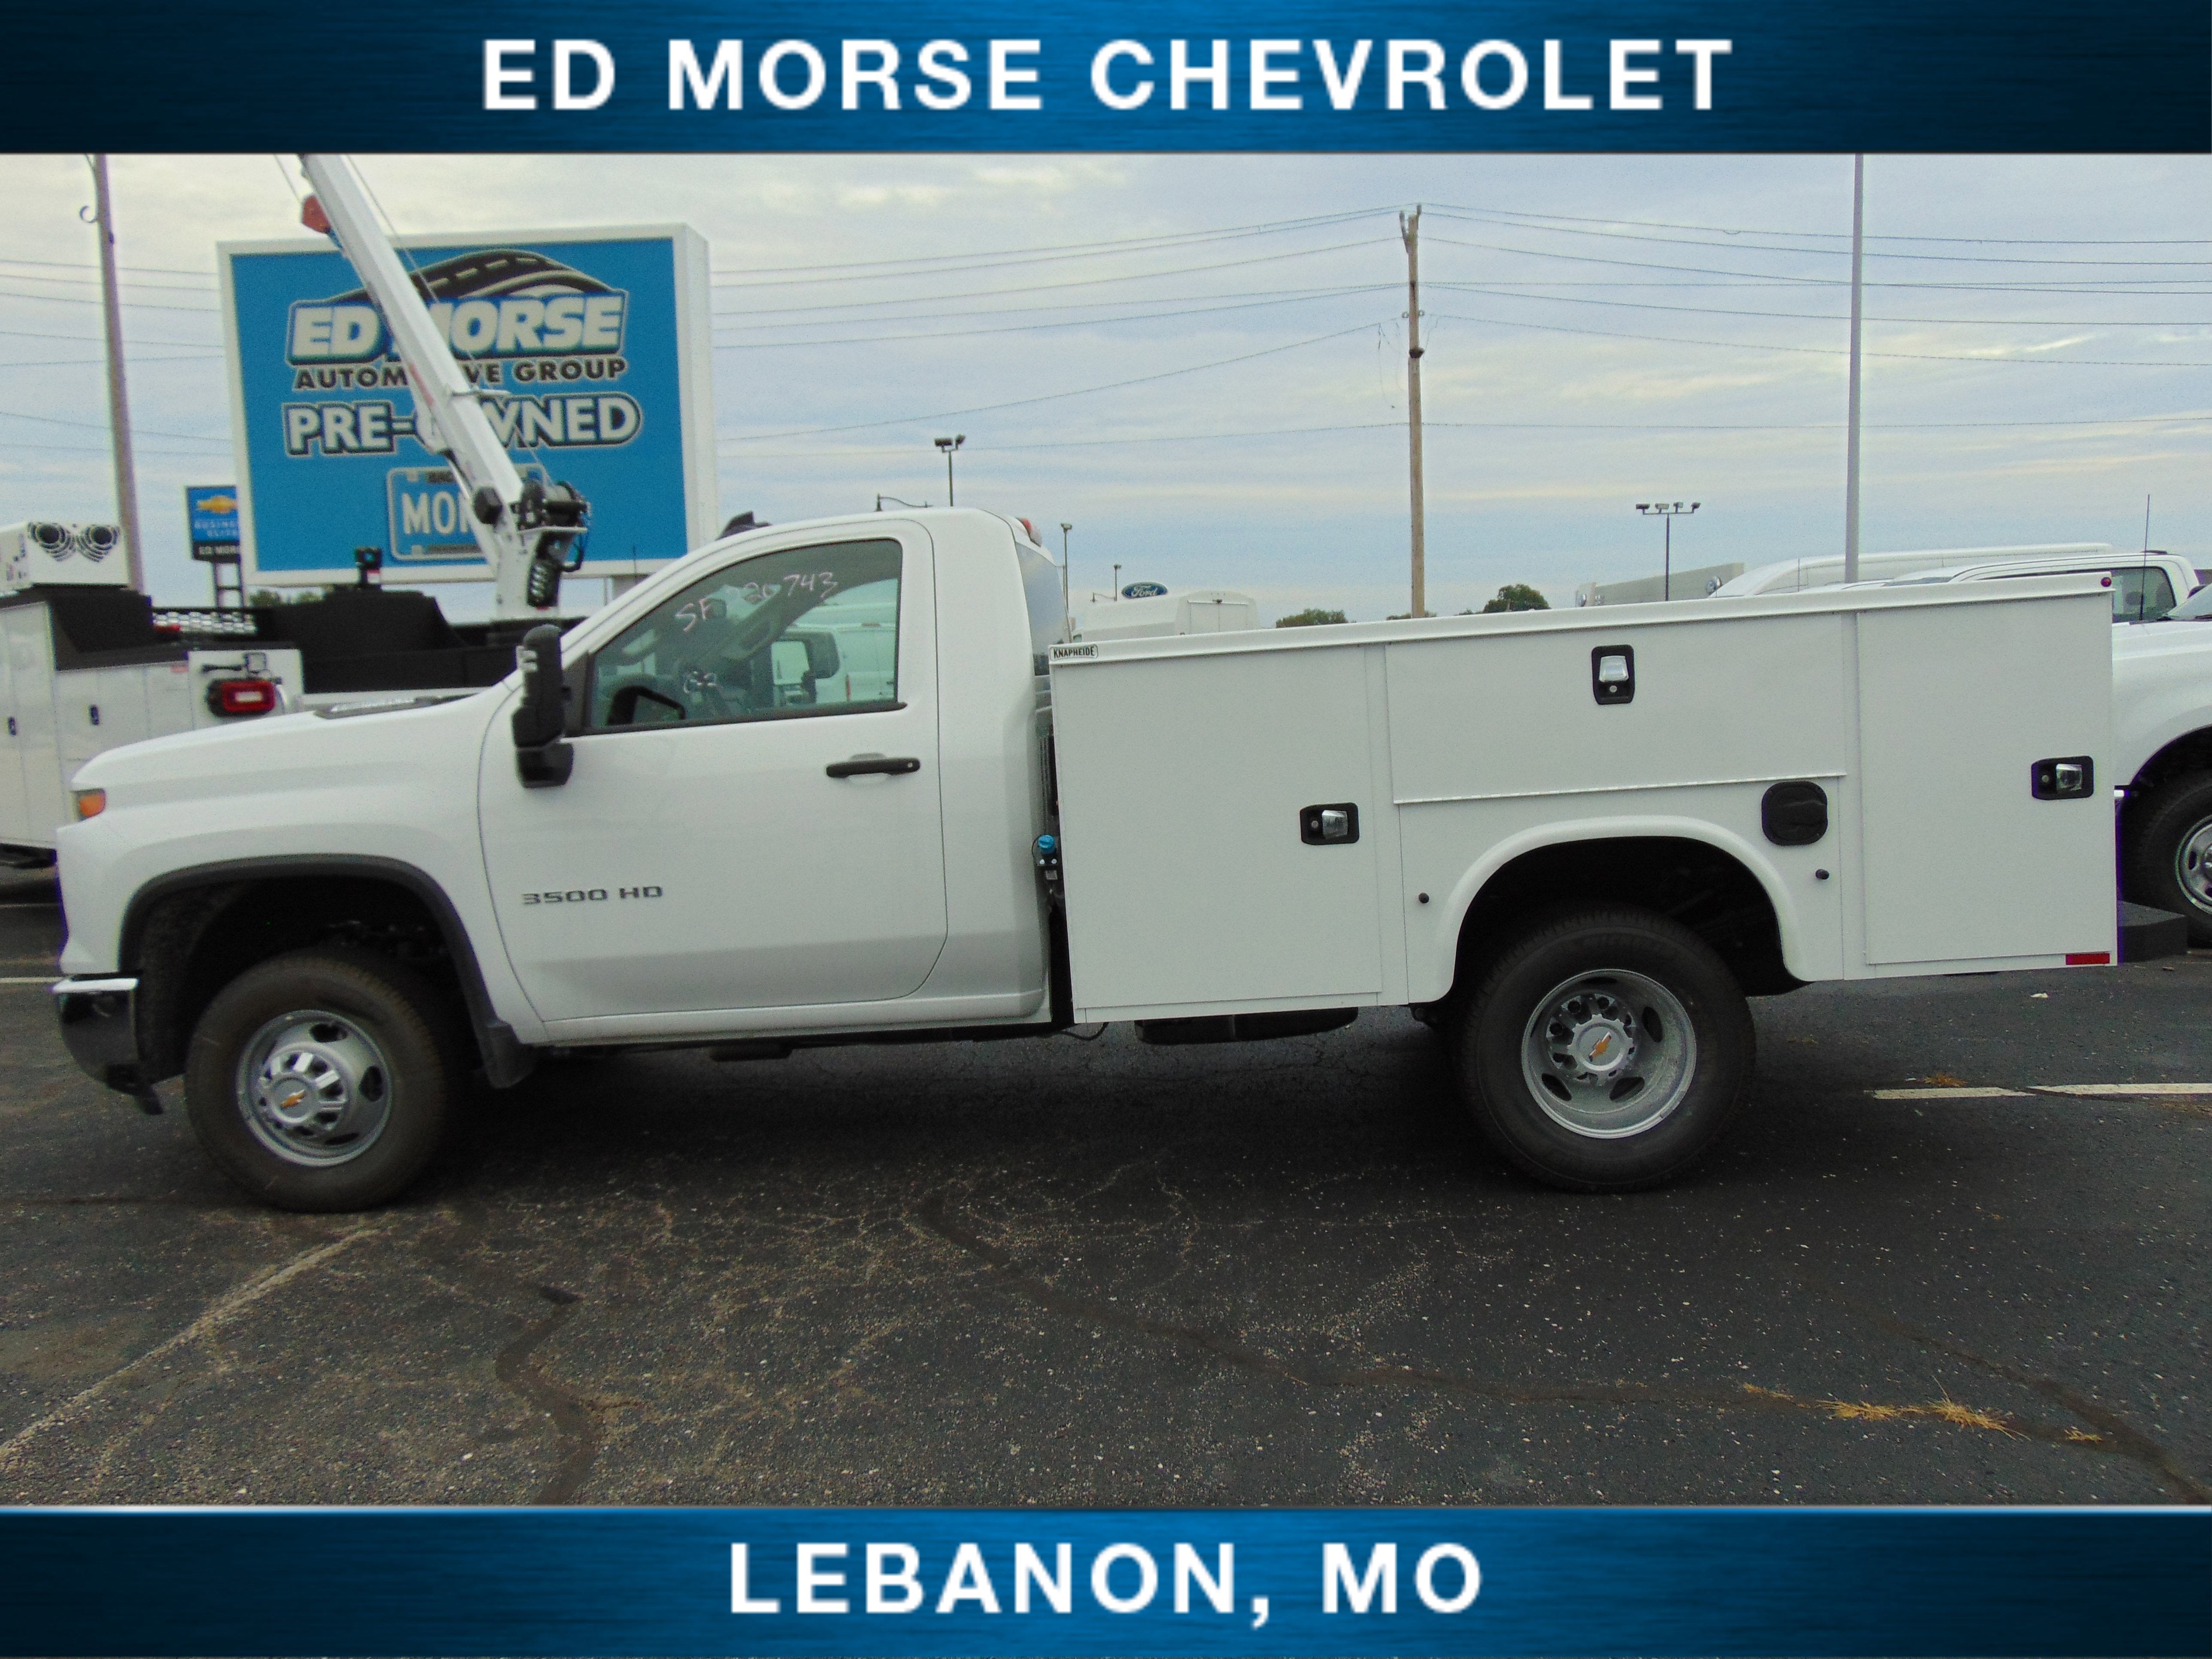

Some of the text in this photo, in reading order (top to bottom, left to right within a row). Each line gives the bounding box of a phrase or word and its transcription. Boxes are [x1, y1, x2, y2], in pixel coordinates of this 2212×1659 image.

[292, 305, 380, 356] ED
[295, 359, 626, 389] AUTOMVE GROUP
[287, 397, 639, 450] PRE-WNED
[1131, 584, 1158, 597] Ford
[1053, 645, 1095, 659] KNAPHEIDE
[521, 885, 663, 905] 3500 HD
